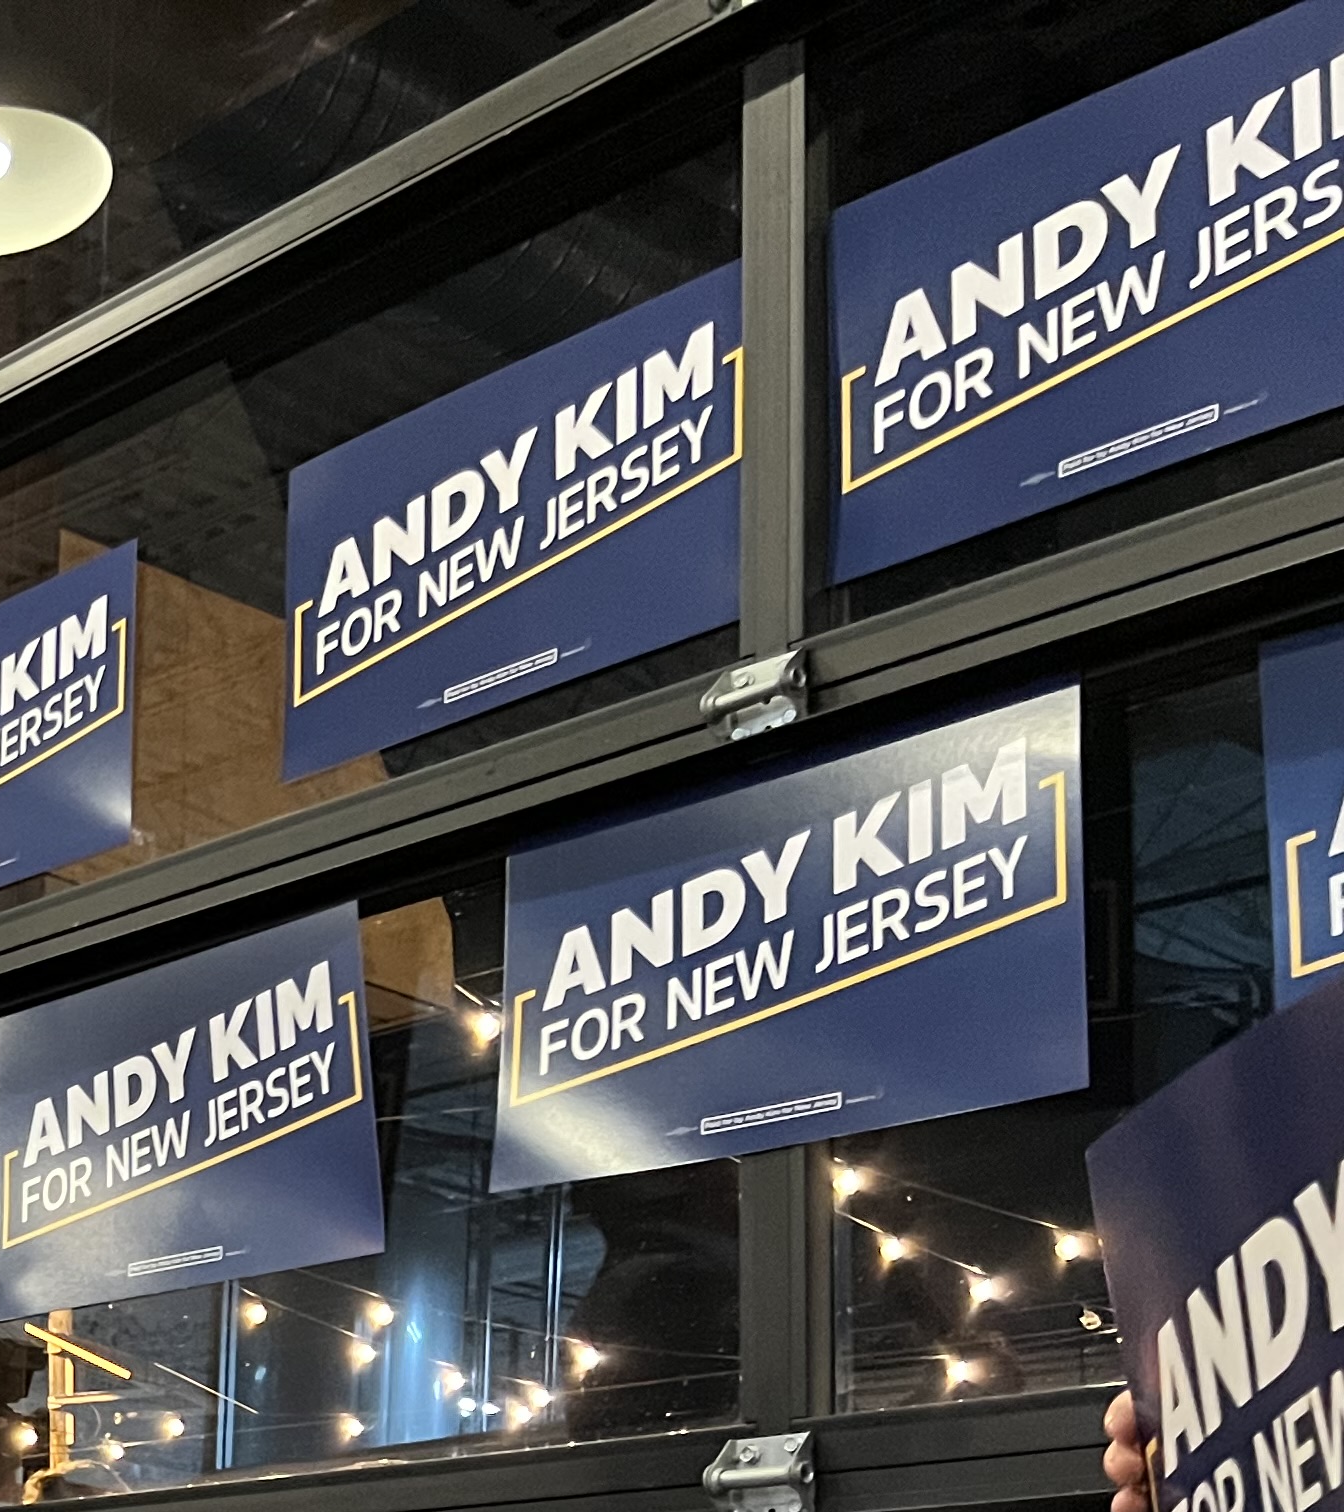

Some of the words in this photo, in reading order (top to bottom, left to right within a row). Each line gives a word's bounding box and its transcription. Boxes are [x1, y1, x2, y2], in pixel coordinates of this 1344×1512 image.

[873, 346, 994, 454] FOR
[1019, 250, 1165, 379] NEW
[1189, 160, 1343, 289] JERS
[875, 144, 1181, 386] ANDY
[1207, 52, 1344, 206] KI
[316, 589, 402, 675] FOR
[418, 516, 524, 618] NEW
[540, 405, 713, 550] JERSEY
[318, 426, 538, 618] ANDY
[555, 321, 714, 480] KIM
[0, 594, 108, 716] KIM
[539, 992, 646, 1076] FOR
[666, 929, 794, 1030] NEW
[815, 835, 1028, 973] JERSEY
[542, 829, 811, 1012] ANDY
[833, 737, 1027, 895] KIM
[21, 1156, 92, 1223] FOR
[106, 1110, 191, 1188] NEW
[204, 1041, 335, 1148] JERSEY
[23, 1026, 196, 1168] ANDY
[209, 960, 334, 1083] KIM
